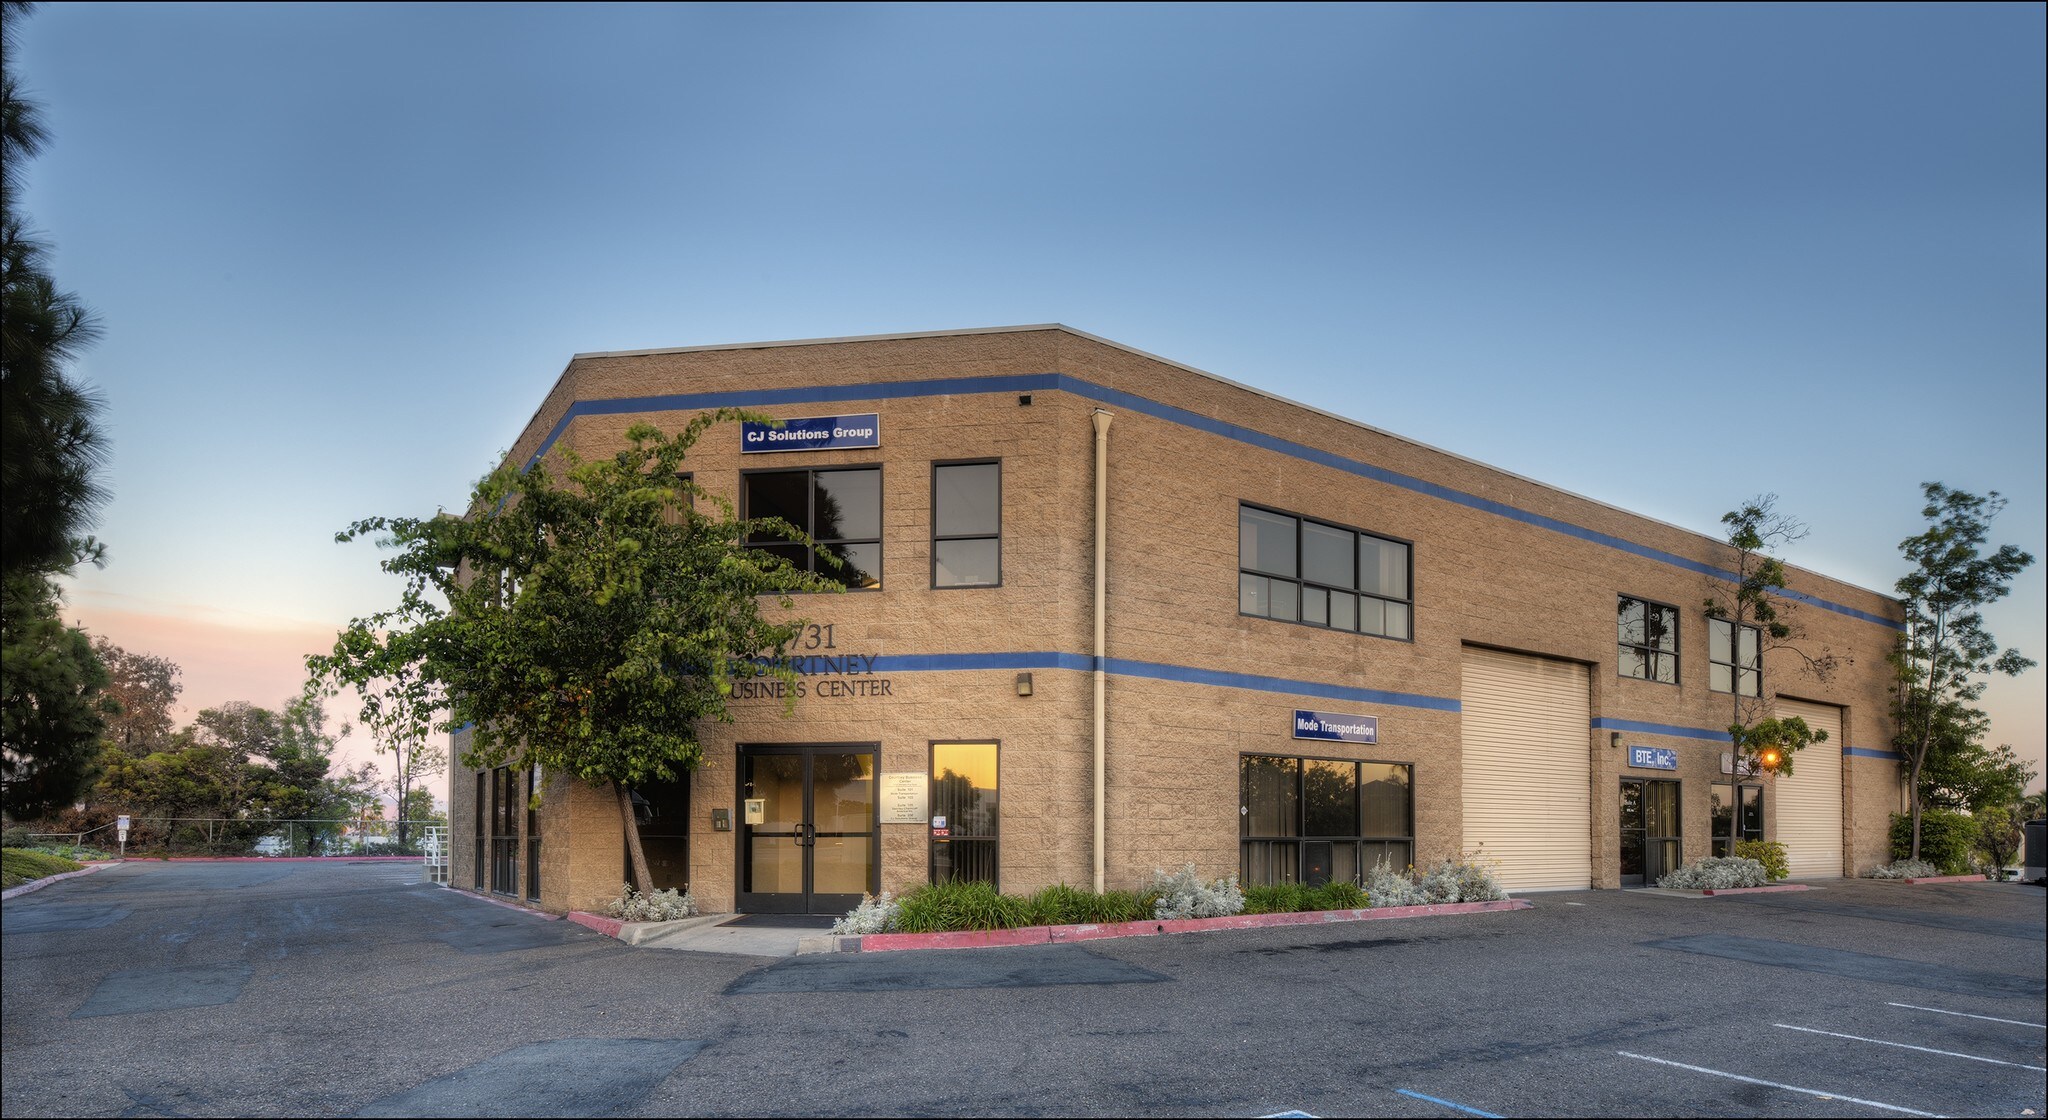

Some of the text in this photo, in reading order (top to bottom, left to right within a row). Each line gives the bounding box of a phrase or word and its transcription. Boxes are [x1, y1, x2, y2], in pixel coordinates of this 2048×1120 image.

[747, 427, 873, 442] CJ Solutions Group
[726, 679, 893, 699] USINESS CENTER
[1297, 718, 1374, 736] Mode Transportation
